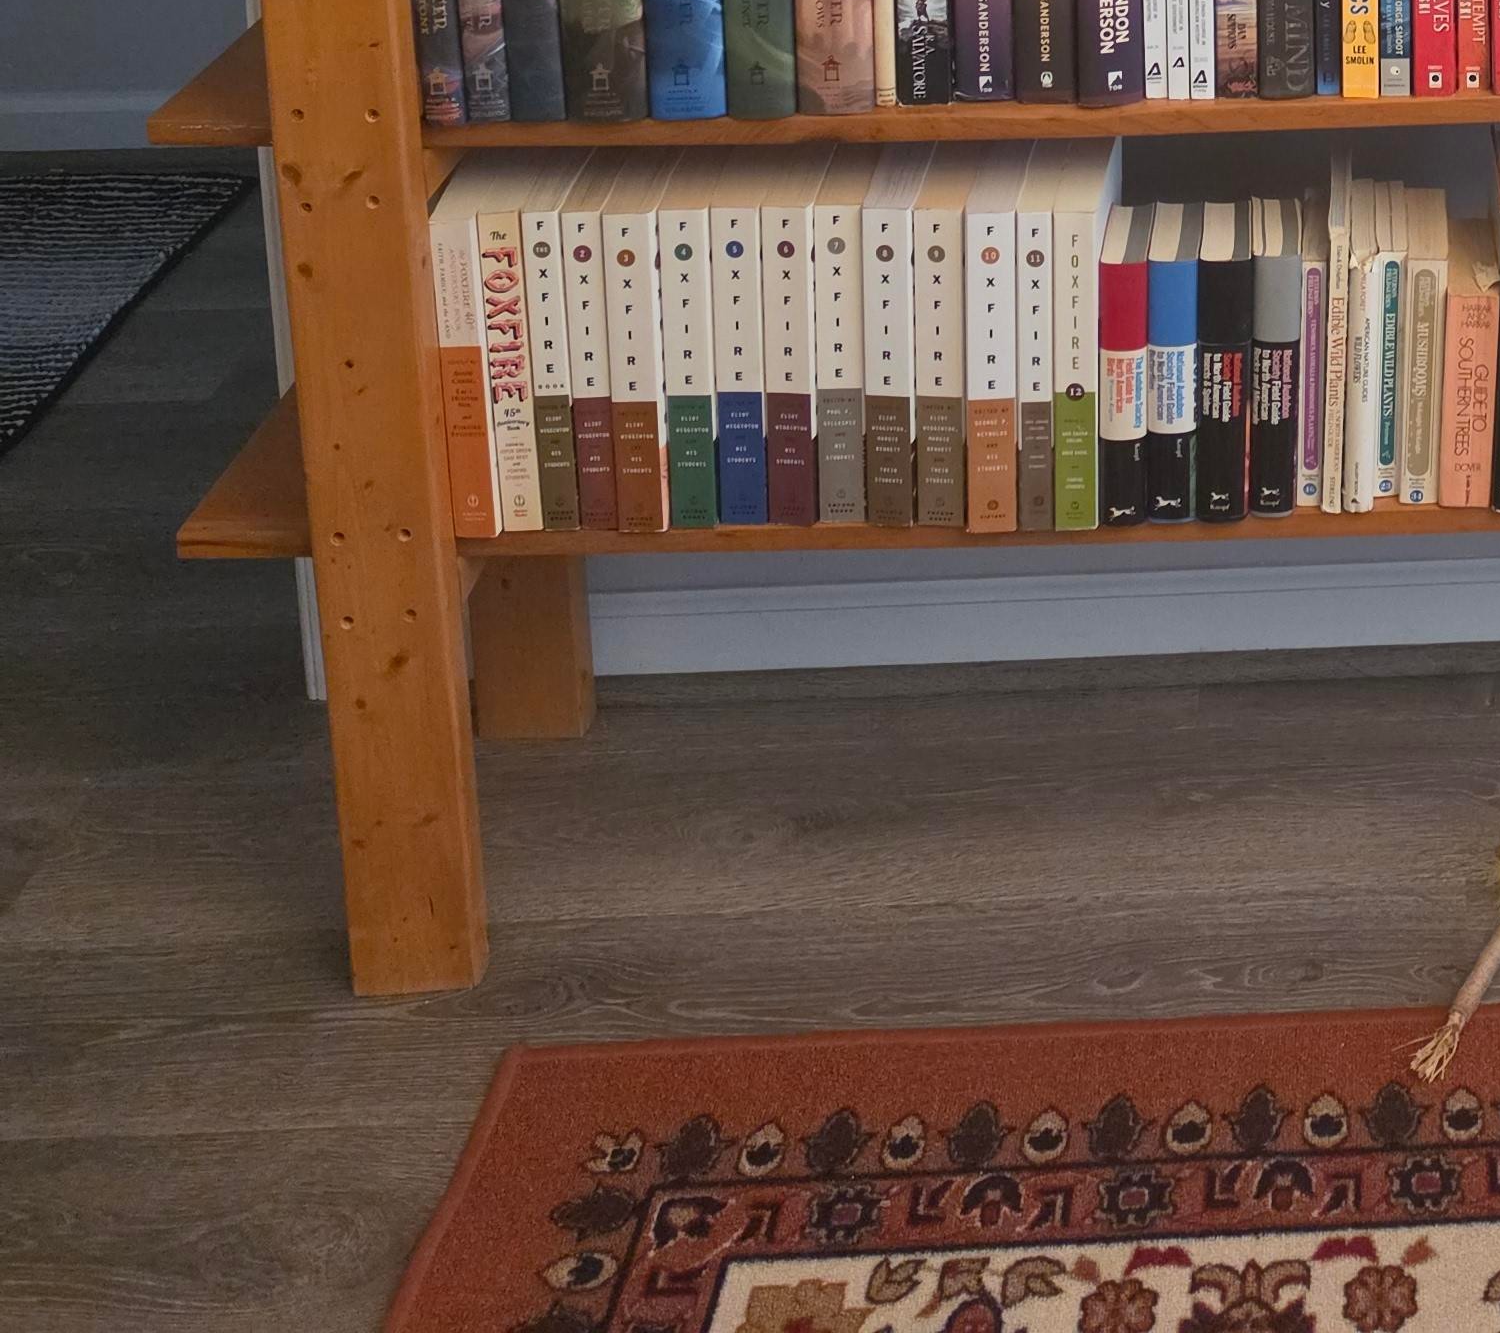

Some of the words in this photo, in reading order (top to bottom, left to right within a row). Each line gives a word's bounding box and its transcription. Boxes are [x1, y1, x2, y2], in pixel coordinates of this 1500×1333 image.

[1030, 255, 1041, 263] 11
[482, 246, 529, 404] FOXFIRE
[1457, 338, 1474, 409] SOUTHERN
[1476, 364, 1490, 404] GUIDE
[1454, 413, 1471, 456] TREES
[1474, 408, 1488, 432] TO
